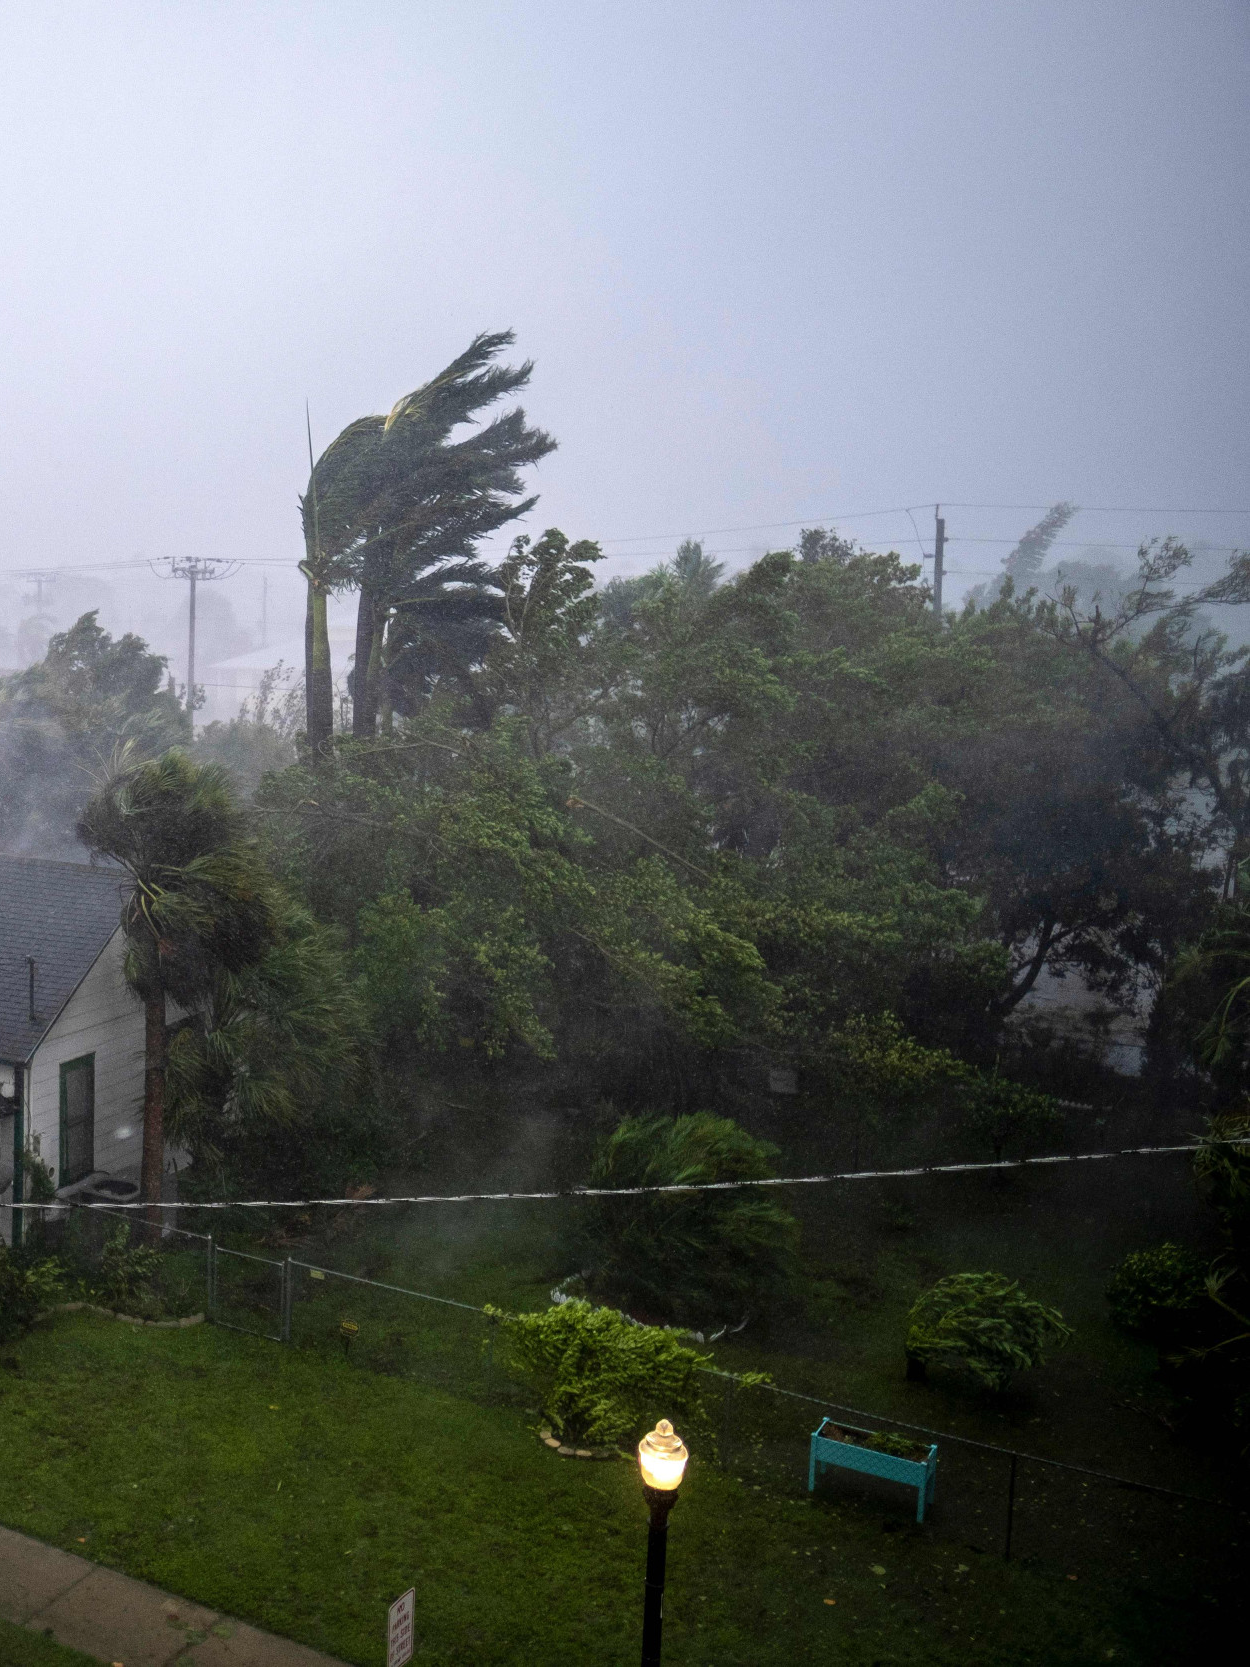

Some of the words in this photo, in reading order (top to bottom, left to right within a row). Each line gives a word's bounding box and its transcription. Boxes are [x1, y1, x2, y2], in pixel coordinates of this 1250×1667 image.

[396, 1601, 405, 1615] NO
[392, 1610, 410, 1633] PARKING
[400, 1622, 411, 1638] SIDE
[396, 1635, 411, 1655] STREET
